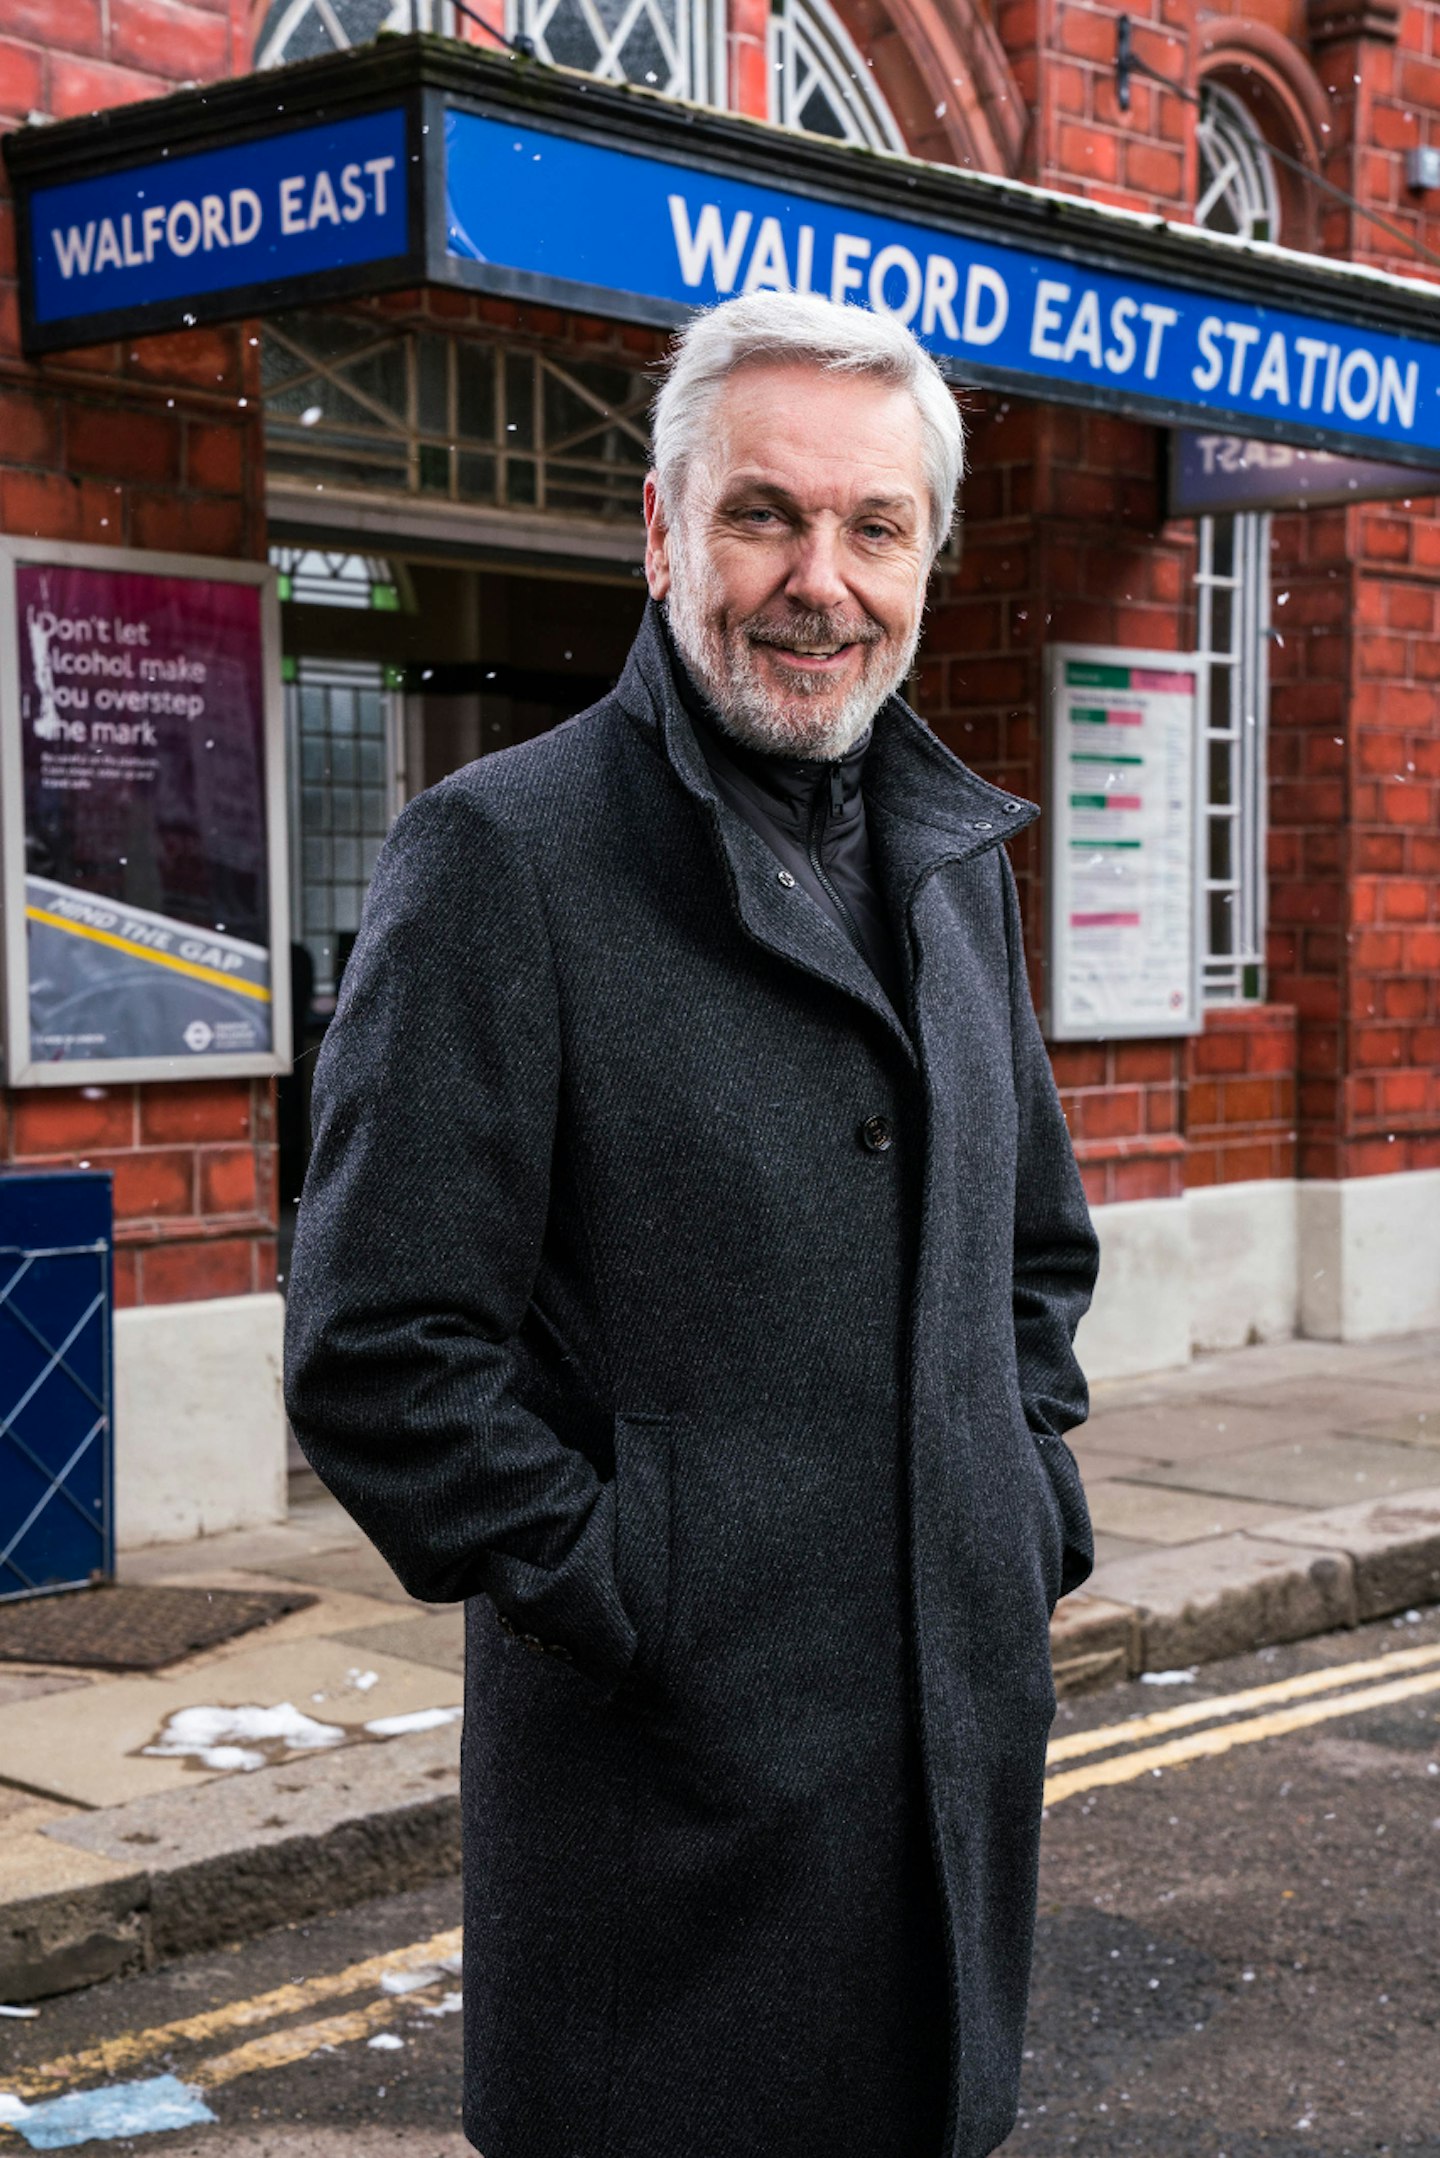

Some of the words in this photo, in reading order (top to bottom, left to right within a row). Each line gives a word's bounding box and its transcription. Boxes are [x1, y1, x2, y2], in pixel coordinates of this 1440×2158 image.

[52, 188, 262, 279] WALFORD
[280, 156, 395, 235] EAST
[668, 195, 1009, 346] WALFORD
[1030, 279, 1177, 380] EAST
[1192, 316, 1419, 429] STATION
[37, 611, 110, 643] Don't
[114, 617, 151, 646] let
[49, 647, 135, 679] lcohol
[139, 655, 207, 683] make
[95, 689, 205, 722] overstep
[91, 720, 158, 747] mark
[179, 939, 243, 971] GAP
